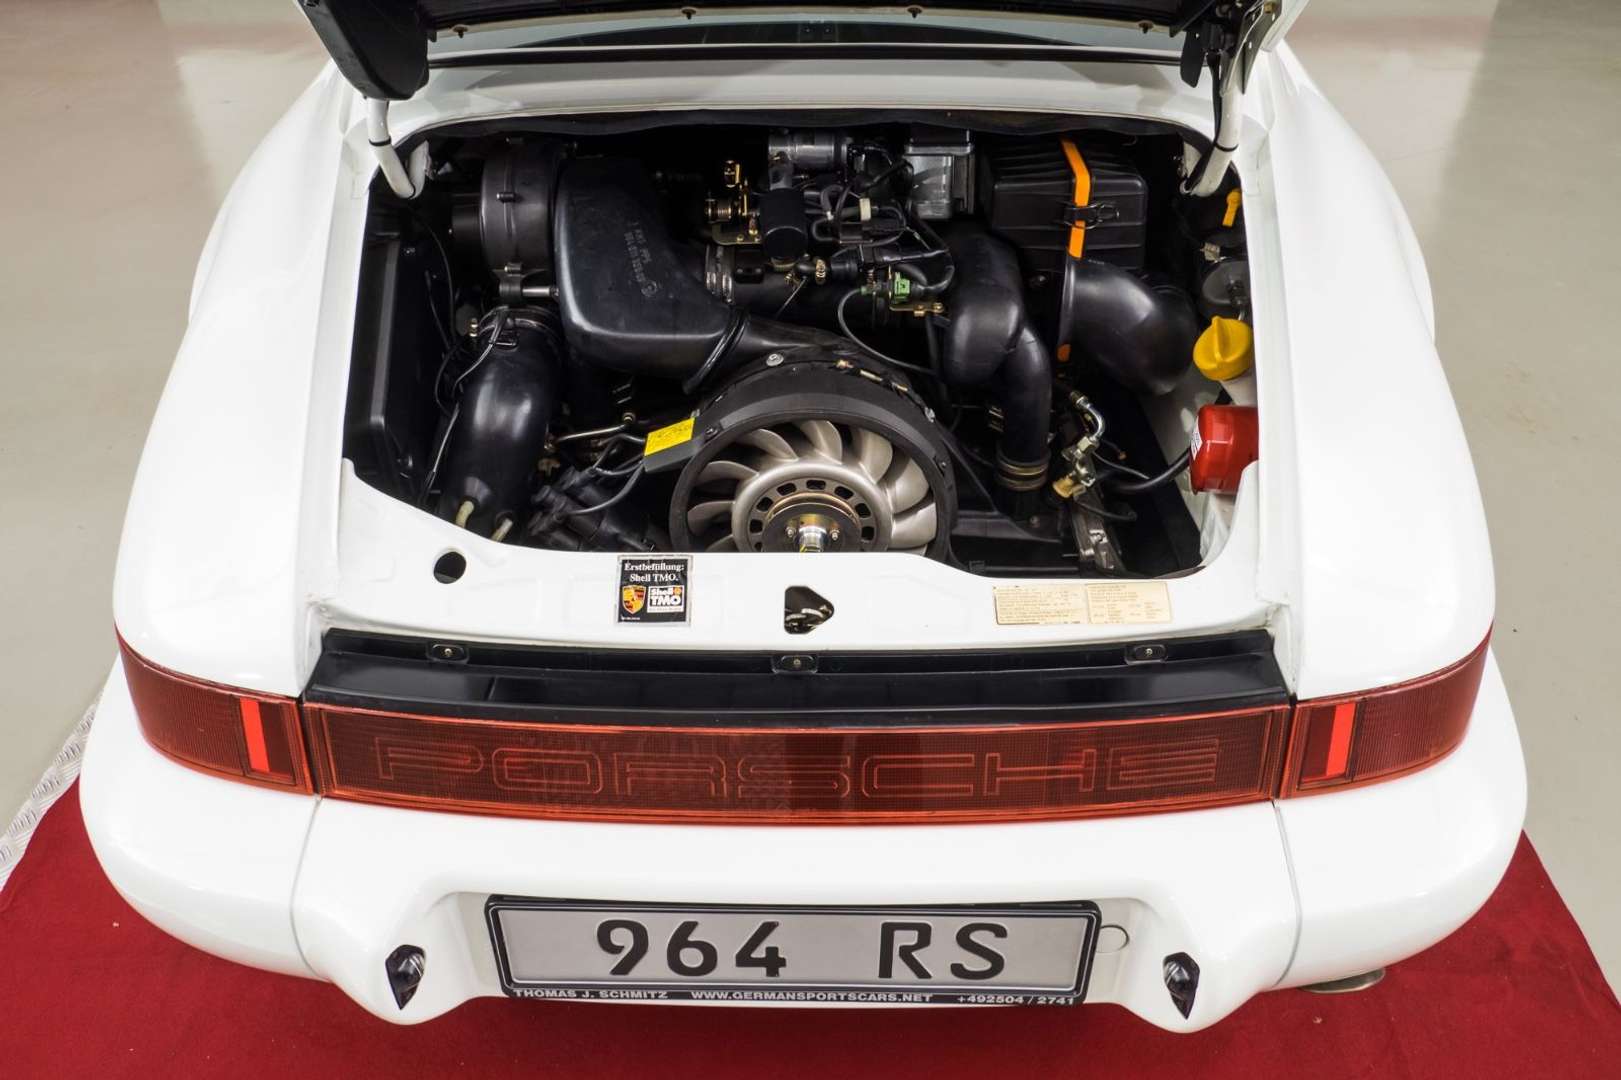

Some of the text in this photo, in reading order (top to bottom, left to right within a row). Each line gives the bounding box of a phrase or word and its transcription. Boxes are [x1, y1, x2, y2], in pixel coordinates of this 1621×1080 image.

[624, 562, 685, 572] Erstbefüllung:
[630, 573, 679, 582] Shell TMO.
[650, 587, 674, 596] Shell
[651, 595, 682, 606] TMO
[374, 736, 1220, 799] PORSCHE
[596, 919, 1008, 980] 964 RS
[513, 988, 577, 998] THOMAS
[582, 989, 595, 998] J.
[599, 990, 668, 999] SCHMITZ
[691, 991, 933, 1002] WWW.GERMANSPORTSCARS.NET
[957, 994, 1026, 1005] +492504
[1036, 996, 1075, 1006] 2741
